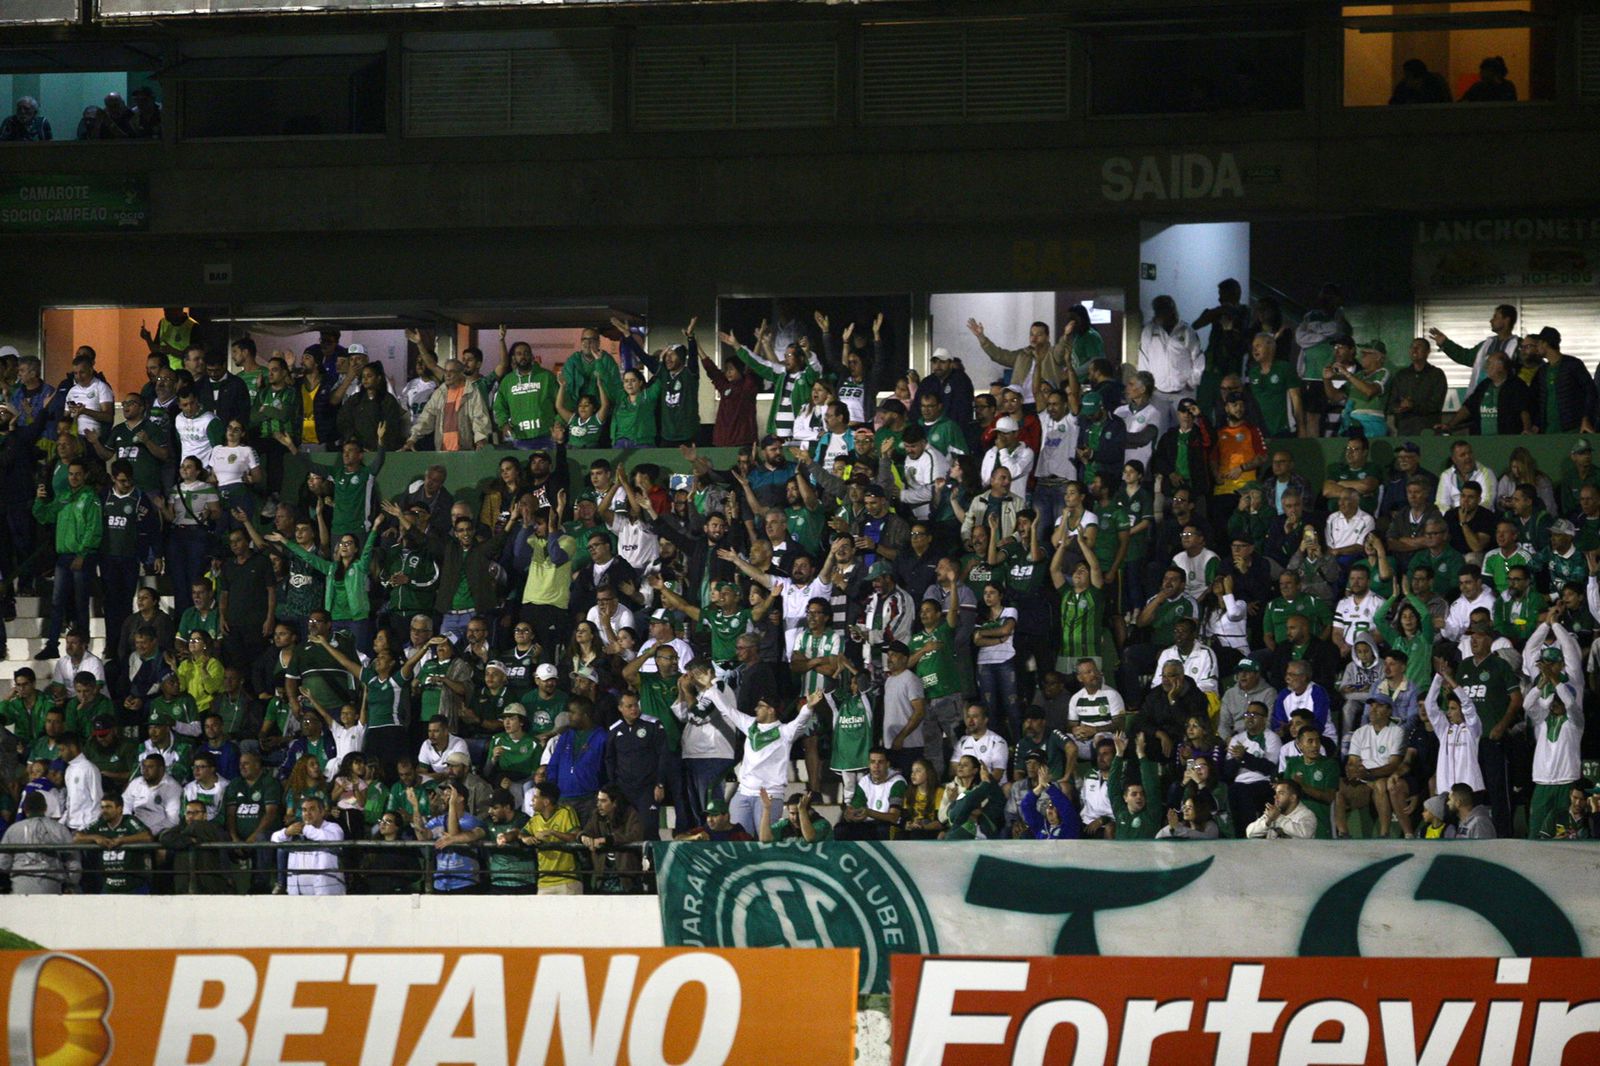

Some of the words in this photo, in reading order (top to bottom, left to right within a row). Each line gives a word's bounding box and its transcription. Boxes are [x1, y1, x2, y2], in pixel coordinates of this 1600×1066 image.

[19, 185, 91, 201] CAMAROTE
[1417, 217, 1600, 242] LANCHONETE
[209, 272, 228, 281] BAR
[519, 418, 541, 431] 1911
[838, 853, 906, 946] CLUBE
[152, 951, 743, 1066] BETANO
